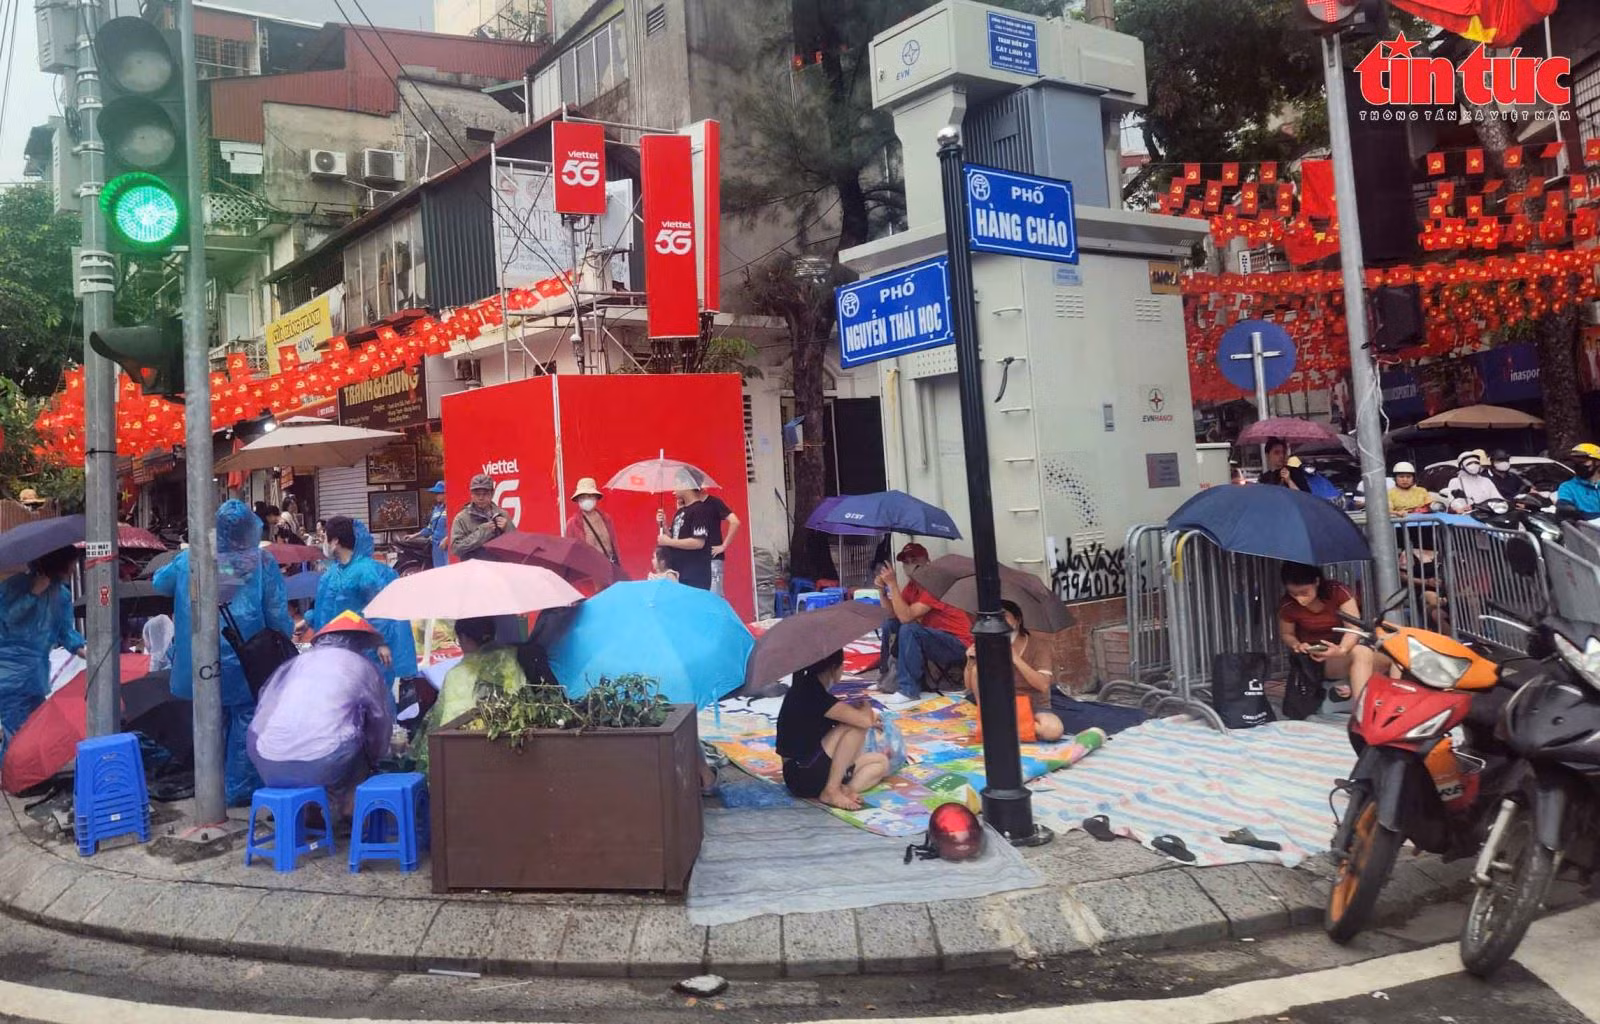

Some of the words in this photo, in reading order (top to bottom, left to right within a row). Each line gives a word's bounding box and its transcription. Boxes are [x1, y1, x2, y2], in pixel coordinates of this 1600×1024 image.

[896, 68, 910, 80] EVN
[568, 150, 599, 160] viettel
[561, 159, 600, 187] 5G
[1011, 184, 1046, 205] PHỐ
[661, 220, 692, 229] viettel
[975, 202, 1022, 242] HÀNG
[1026, 212, 1068, 248] CHÁO
[654, 229, 692, 255] 5G
[879, 273, 915, 304] PHỐ
[845, 308, 888, 353] NGUYỄN
[889, 304, 916, 342] THÁI
[917, 302, 942, 339] HỌC
[482, 458, 519, 475] viettel
[492, 478, 522, 529] G
